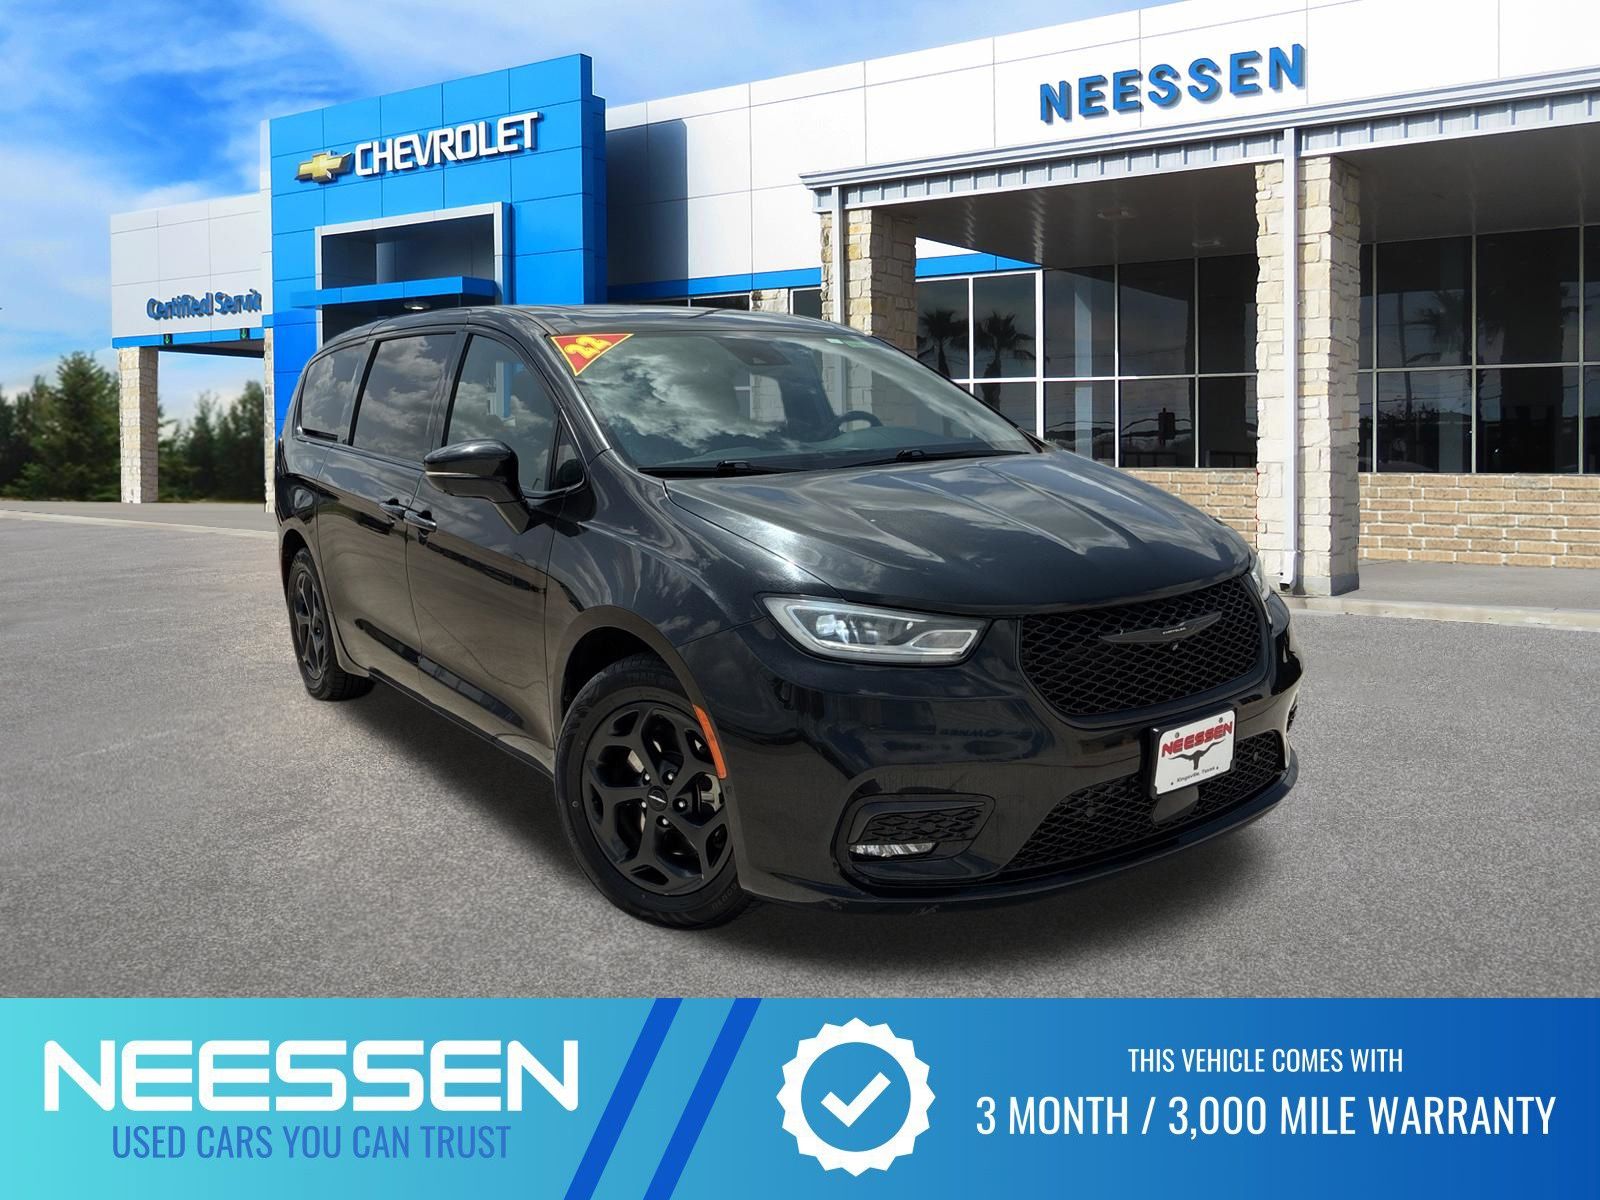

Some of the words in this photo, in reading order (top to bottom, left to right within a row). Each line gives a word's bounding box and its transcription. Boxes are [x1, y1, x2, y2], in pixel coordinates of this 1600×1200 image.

[1039, 43, 1306, 124] NEESSEN
[354, 111, 541, 177] CHEVROLET
[147, 292, 214, 320] Certified
[1161, 721, 1233, 758] NEESSEN
